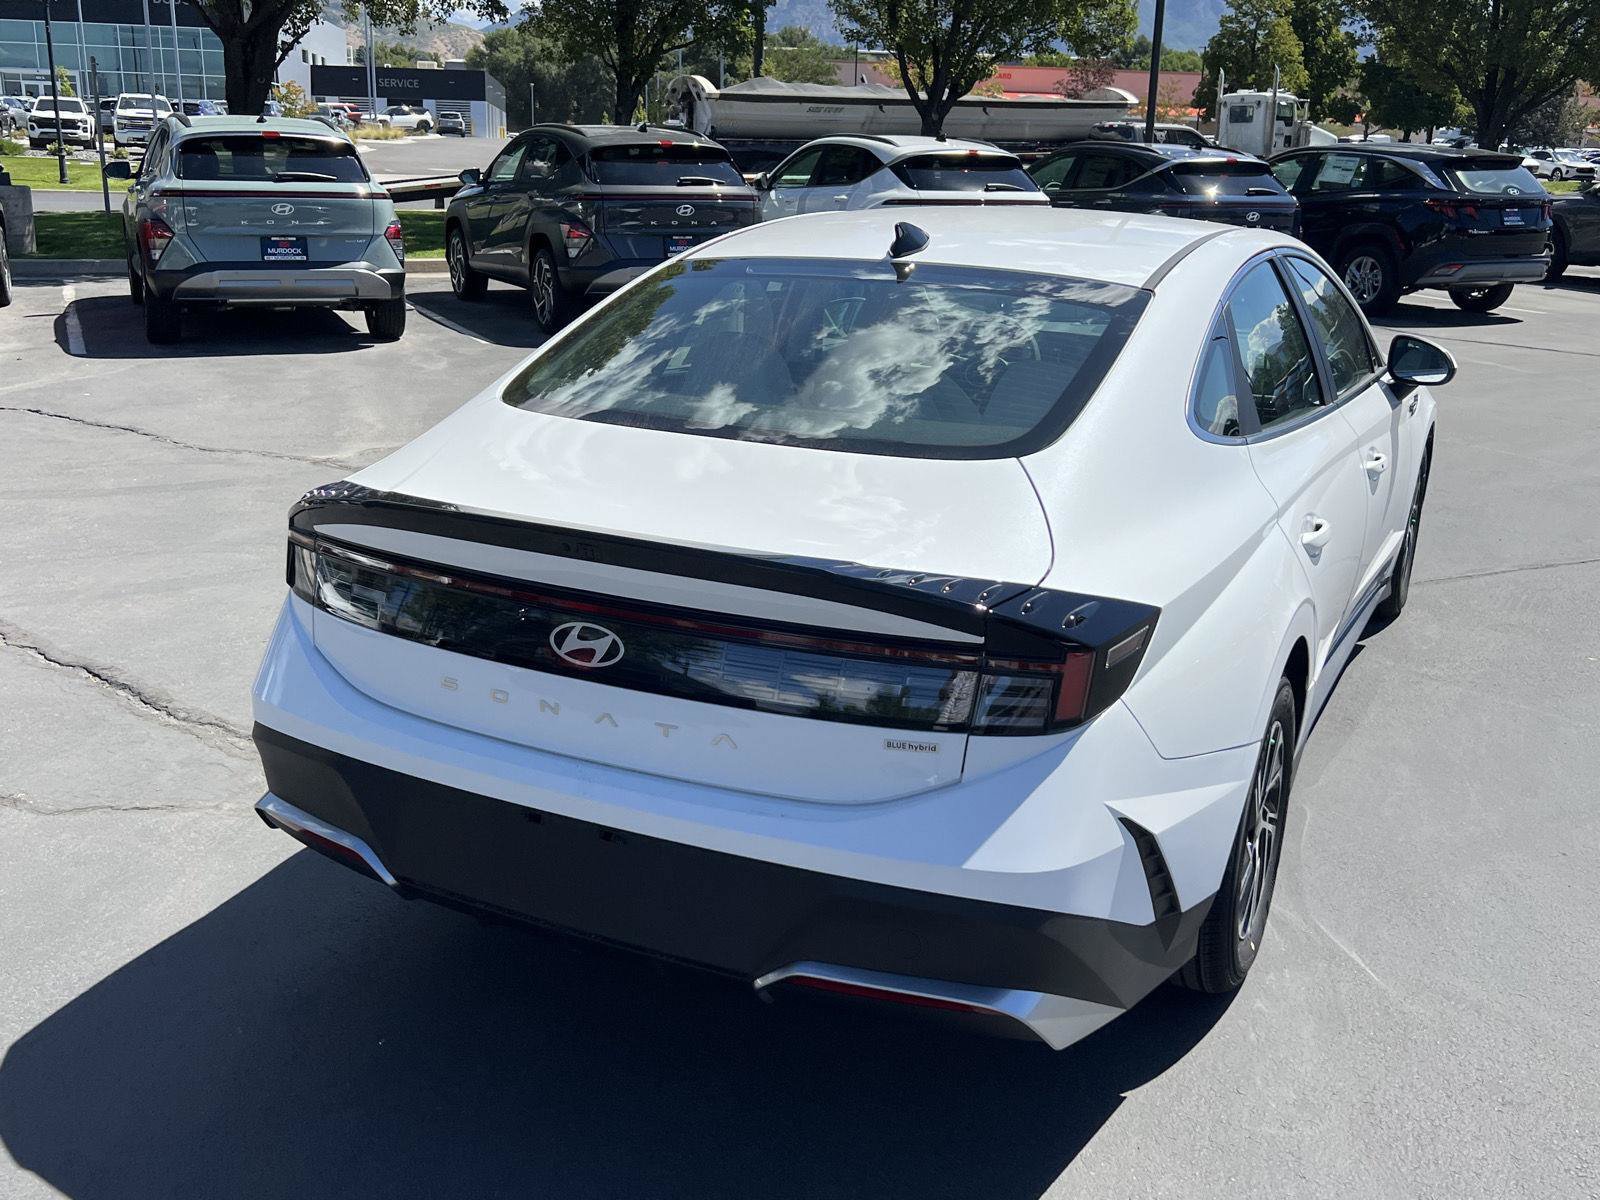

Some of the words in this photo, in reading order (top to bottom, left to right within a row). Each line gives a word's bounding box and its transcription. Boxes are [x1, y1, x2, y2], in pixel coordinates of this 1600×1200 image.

[378, 78, 420, 89] SERVICE
[440, 675, 738, 750] SONATA
[886, 741, 907, 750] BLUE
[908, 743, 937, 752] hybrid
